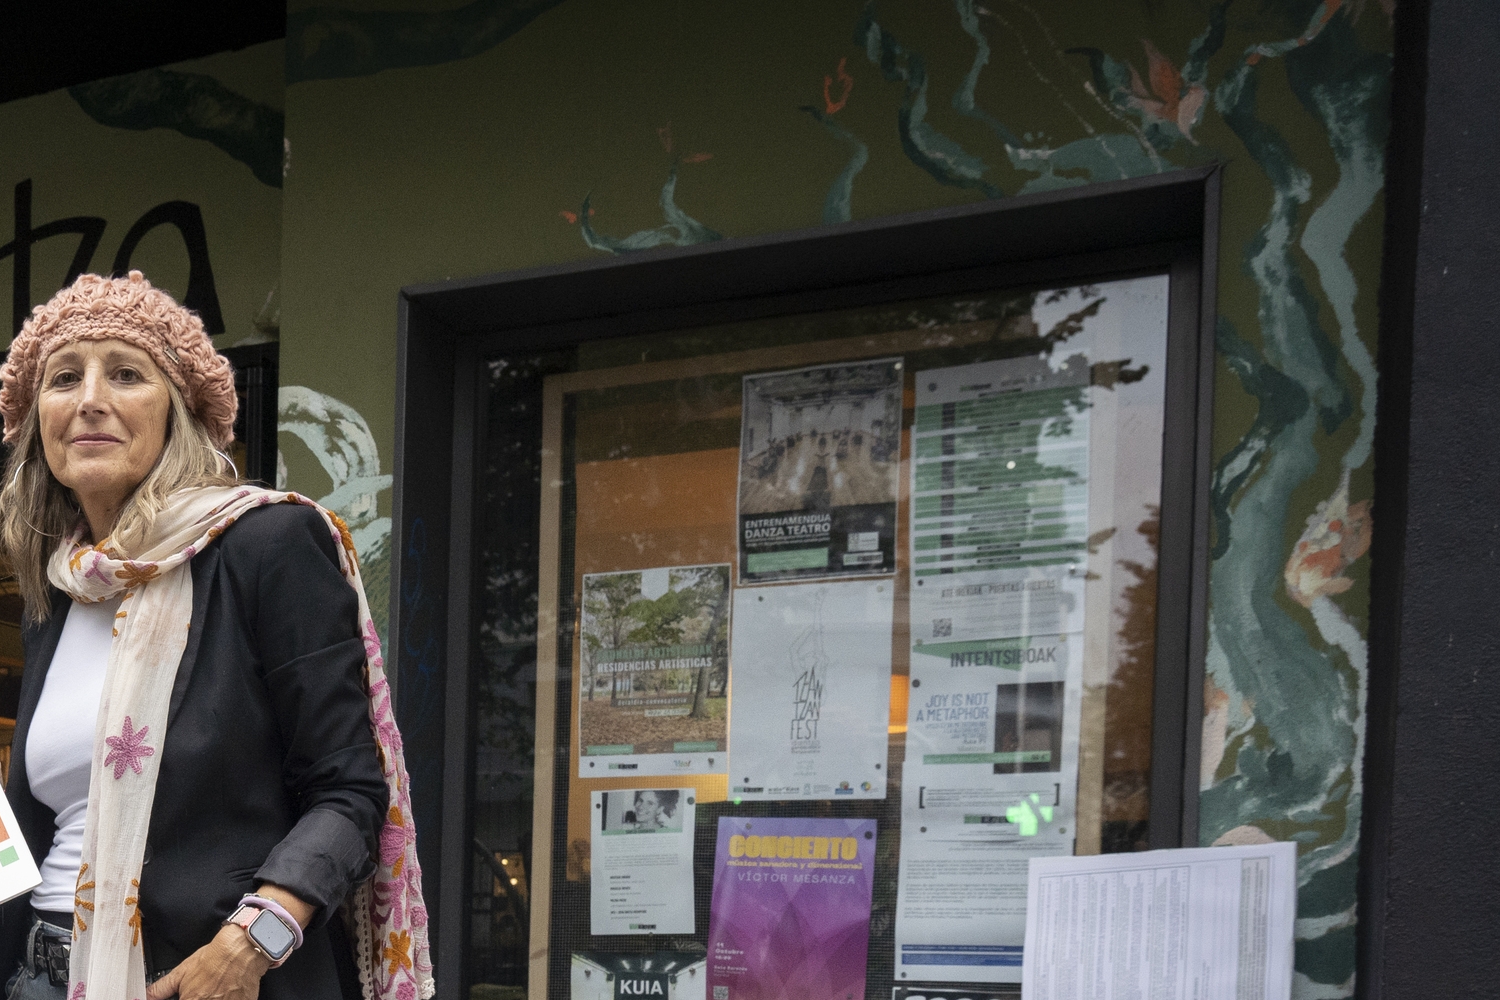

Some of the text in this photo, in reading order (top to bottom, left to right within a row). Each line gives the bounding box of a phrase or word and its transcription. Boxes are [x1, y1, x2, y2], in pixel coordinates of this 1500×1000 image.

[745, 514, 832, 529] ENTRENAMENDUA
[745, 527, 785, 540] DANZA
[787, 523, 831, 535] TEATRO
[597, 657, 713, 673] RESIDENCIAS ARTÍSTICAS
[926, 692, 990, 708] JOY IS NOT
[916, 707, 990, 722] A METAPHOR
[790, 718, 819, 740] FEST
[728, 834, 858, 860] CONCIERTO
[737, 870, 856, 885] VÍCTOR MESANZA
[620, 979, 664, 995] KUIA
